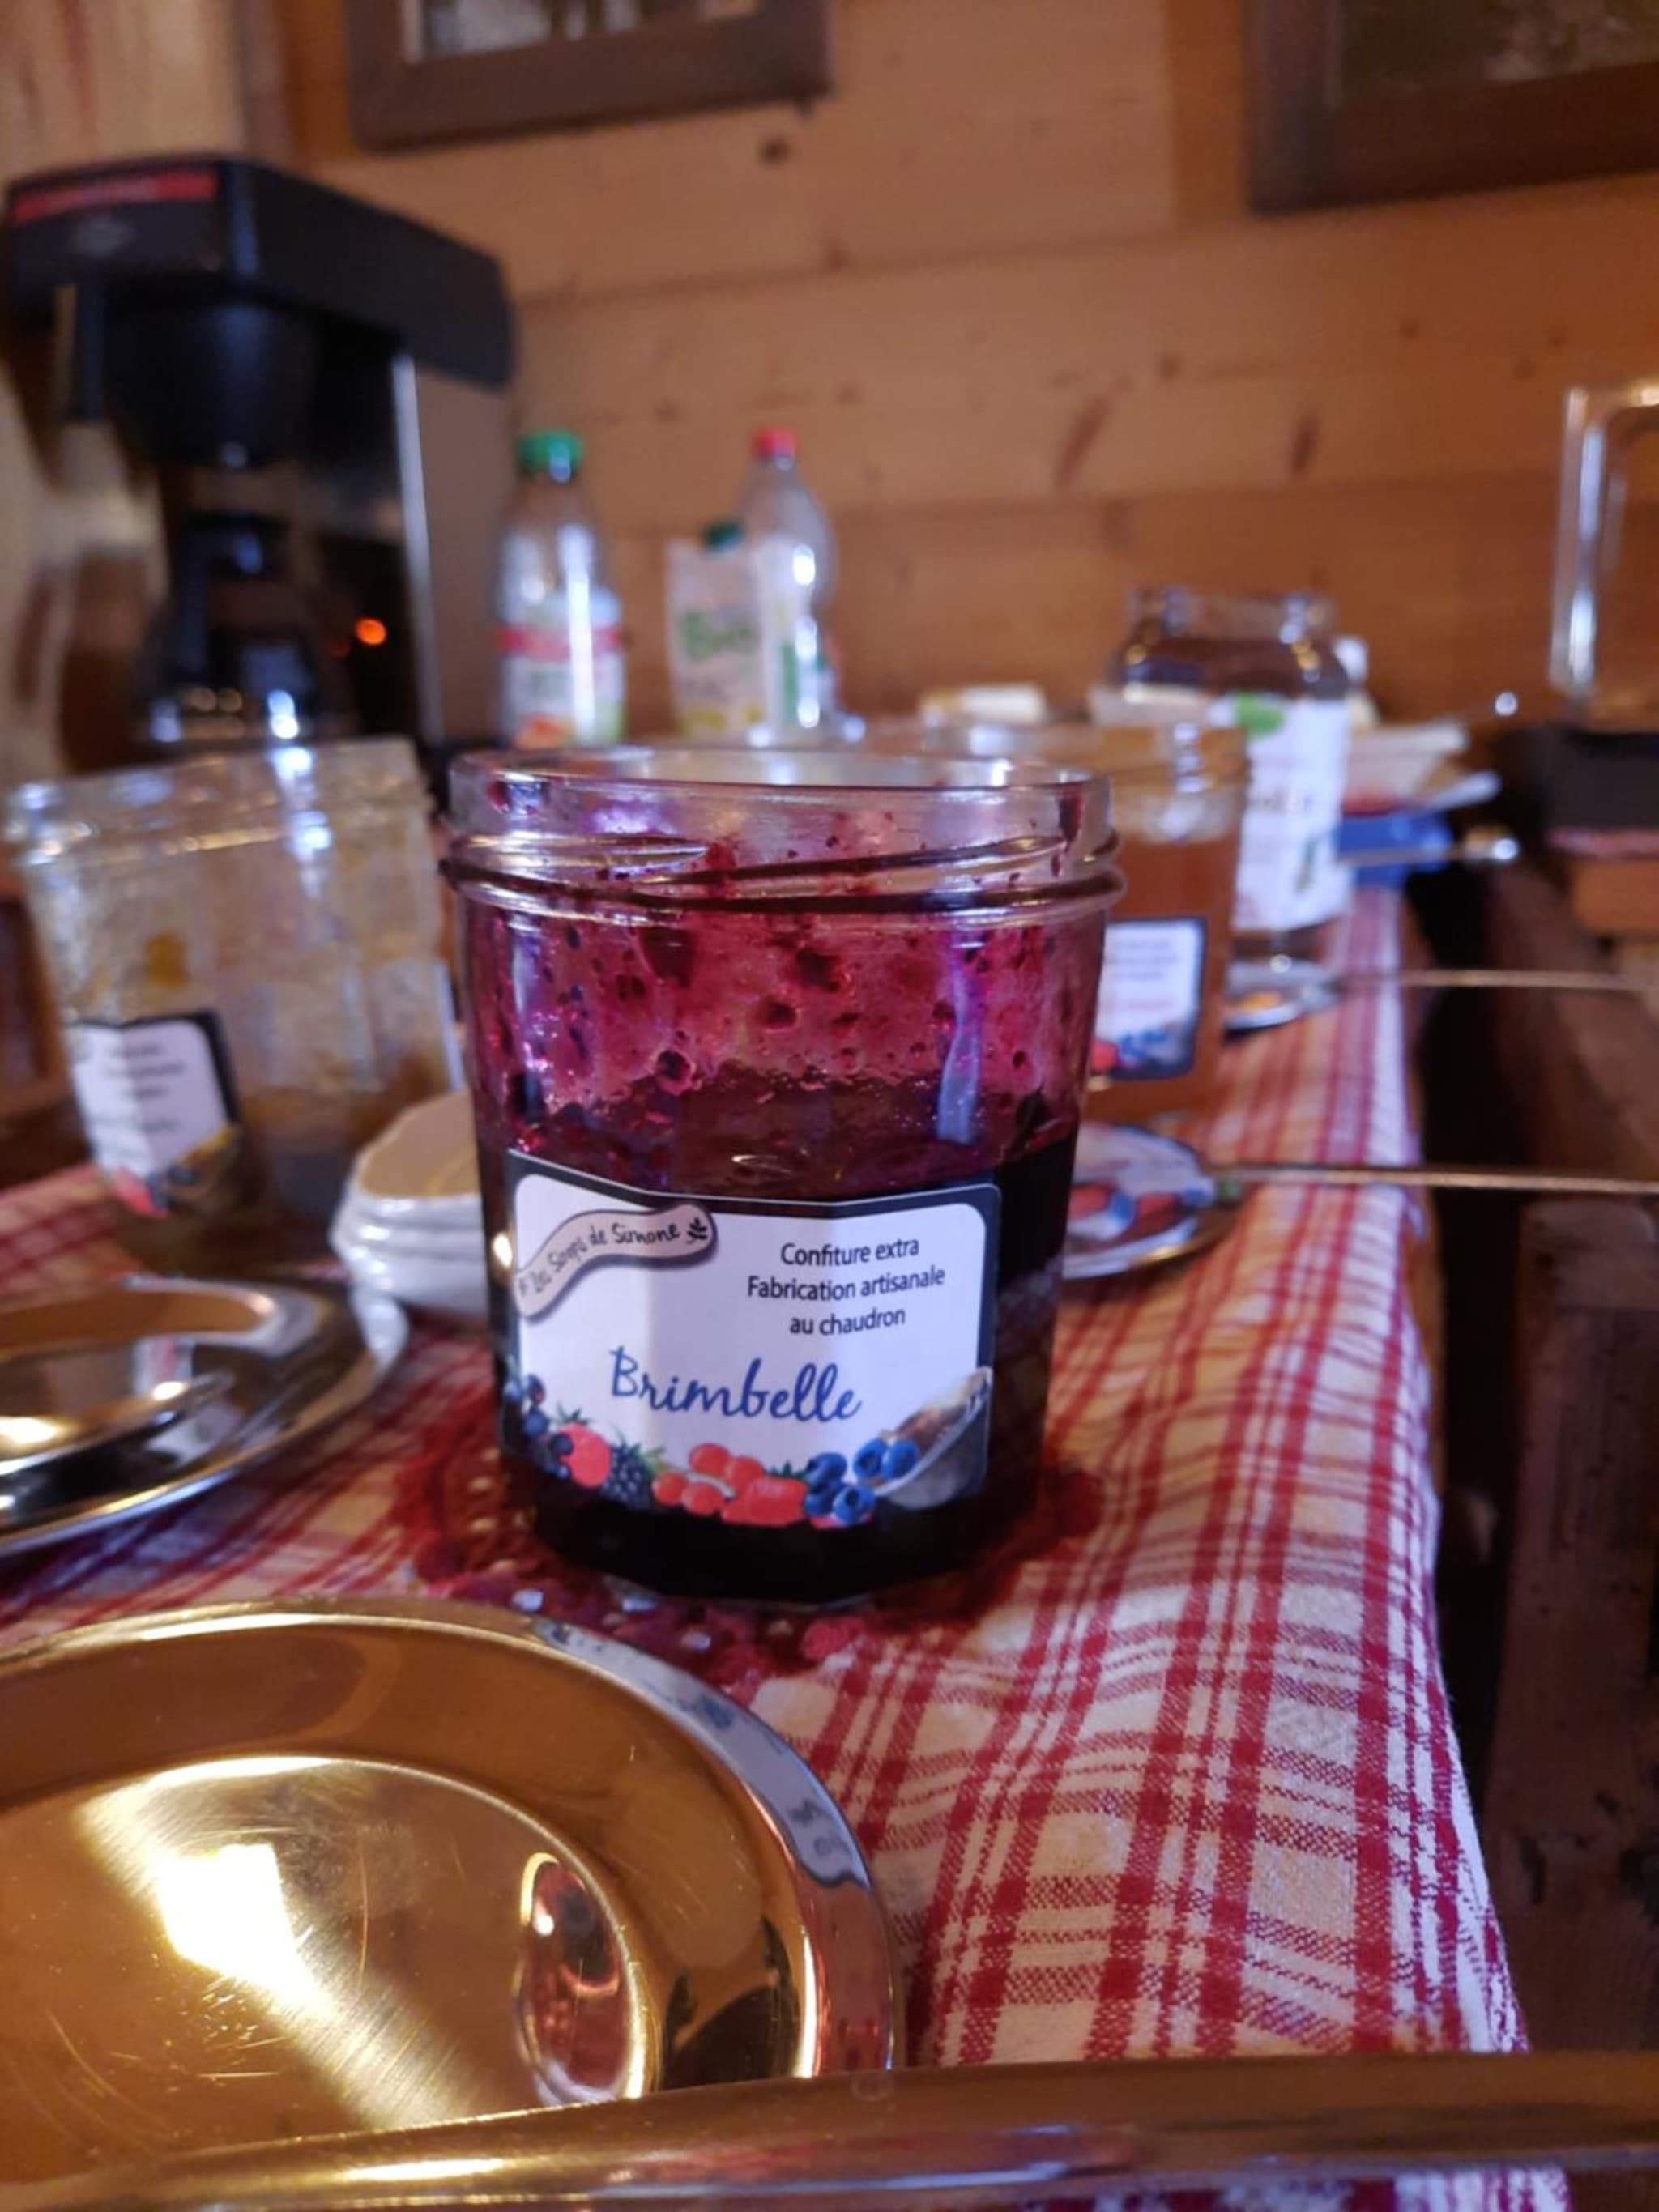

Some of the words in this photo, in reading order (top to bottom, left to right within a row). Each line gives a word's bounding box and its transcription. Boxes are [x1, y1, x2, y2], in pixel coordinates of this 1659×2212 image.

[590, 1224, 607, 1246] de
[612, 1221, 682, 1246] Simone
[779, 1242, 872, 1268] Confiture
[875, 1238, 920, 1261] extra
[746, 1274, 856, 1302] Fabrication
[859, 1263, 946, 1298] artisanale
[788, 1316, 814, 1335] au
[818, 1306, 906, 1336] chaudron
[608, 1345, 863, 1423] Brimbelle
